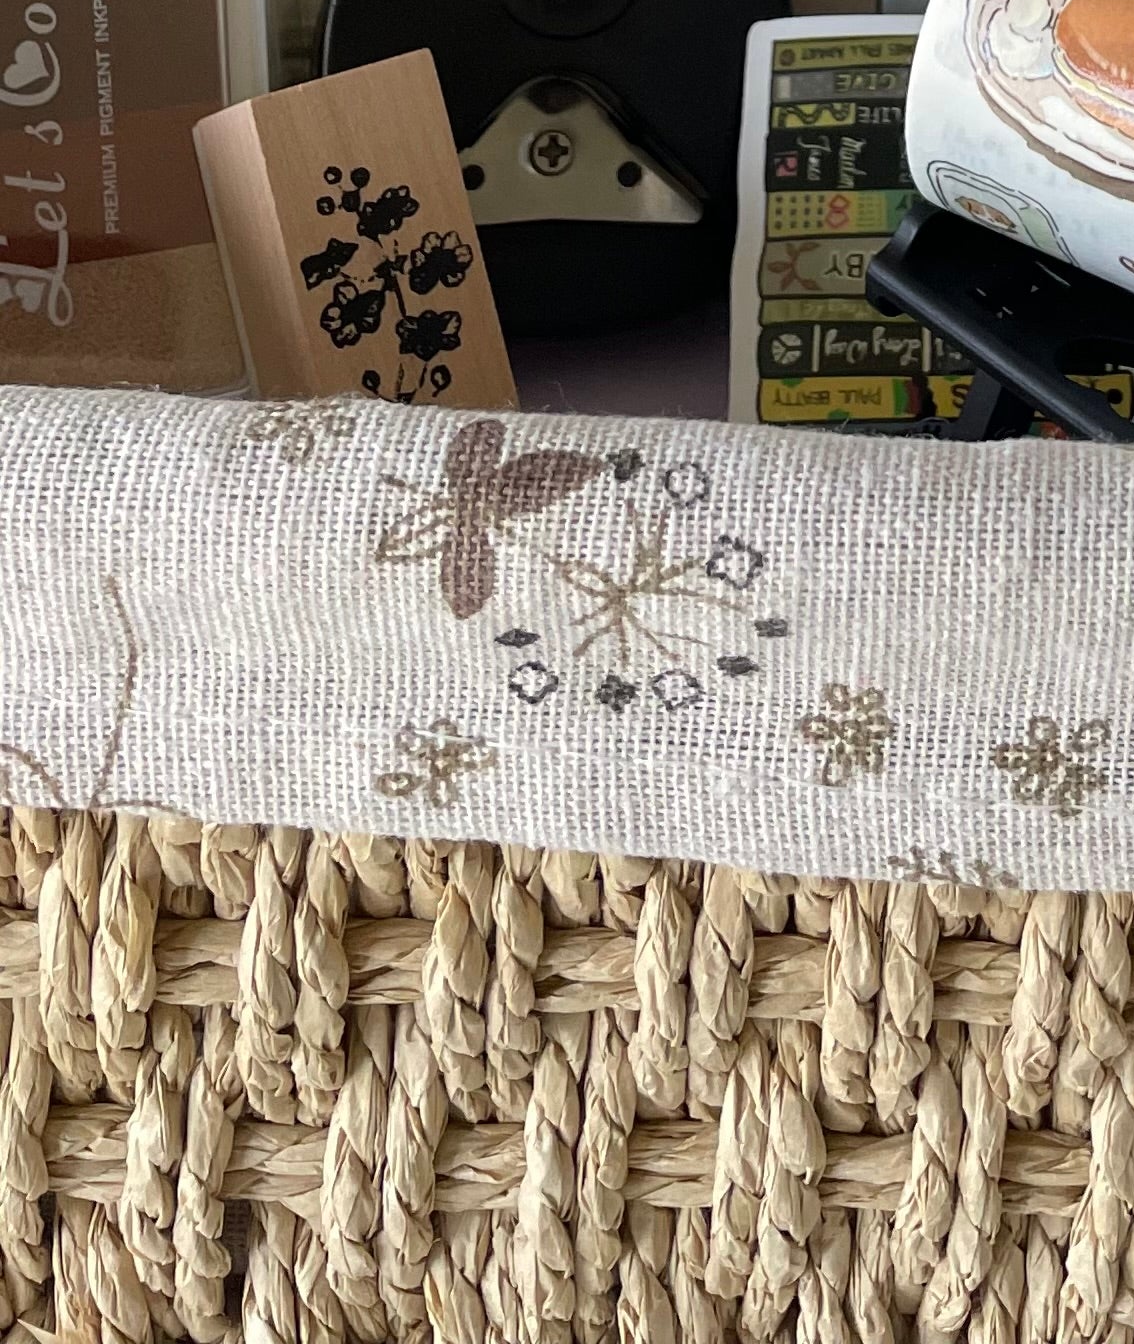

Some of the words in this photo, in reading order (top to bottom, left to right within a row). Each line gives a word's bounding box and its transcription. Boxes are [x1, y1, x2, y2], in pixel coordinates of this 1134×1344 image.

[98, 50, 115, 136] PIGMENT
[0, 118, 74, 328] Lets
[103, 143, 121, 235] PREMIUM
[824, 253, 865, 279] BY
[838, 386, 884, 407] PAUL
